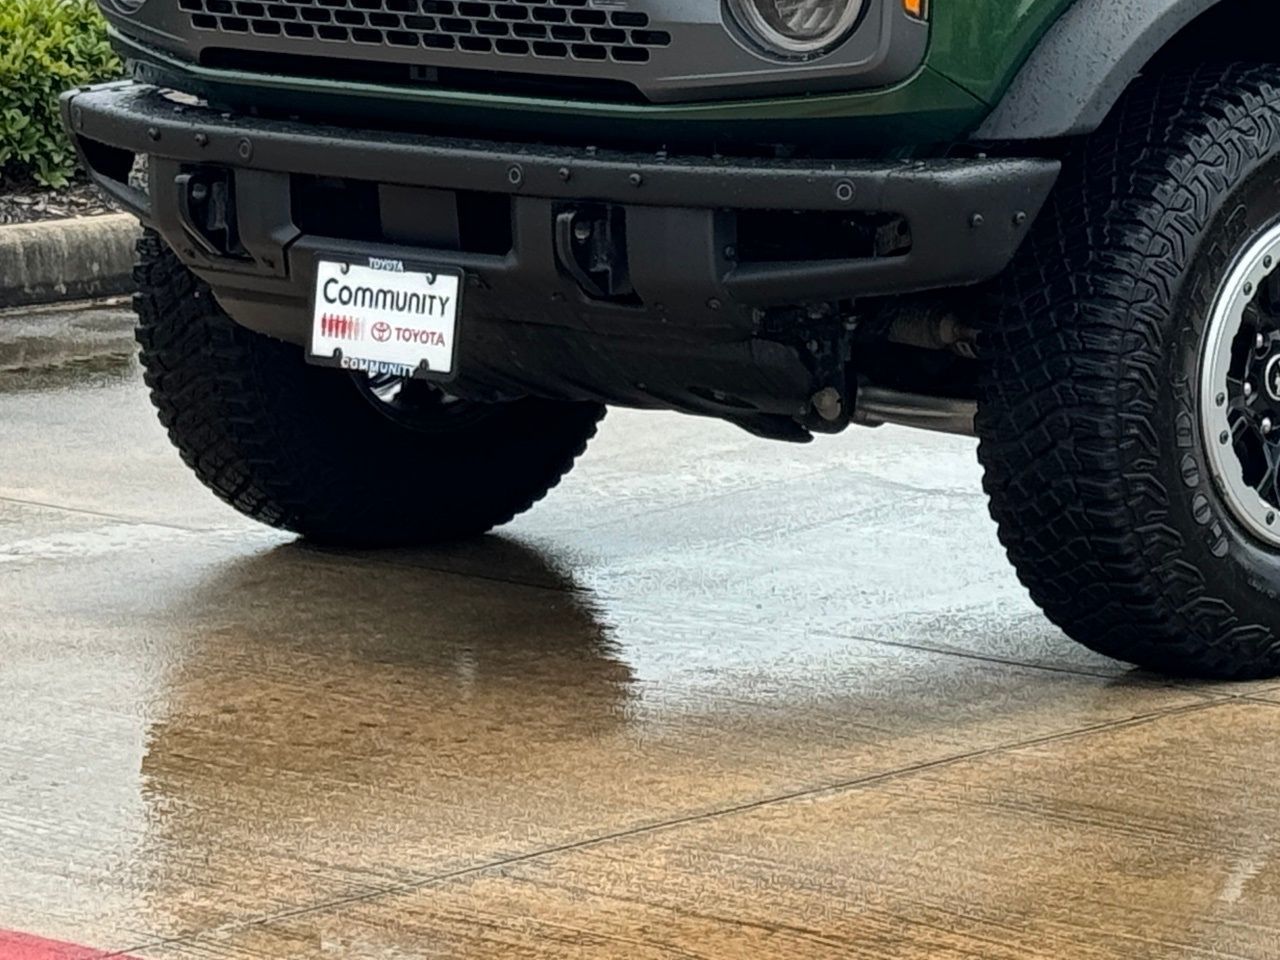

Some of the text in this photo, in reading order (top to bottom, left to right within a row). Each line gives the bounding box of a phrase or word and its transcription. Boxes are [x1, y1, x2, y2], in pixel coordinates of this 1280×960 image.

[368, 257, 404, 273] TOYOTA
[395, 327, 445, 347] TOYOTA
[340, 356, 415, 378] COMMUNITY
